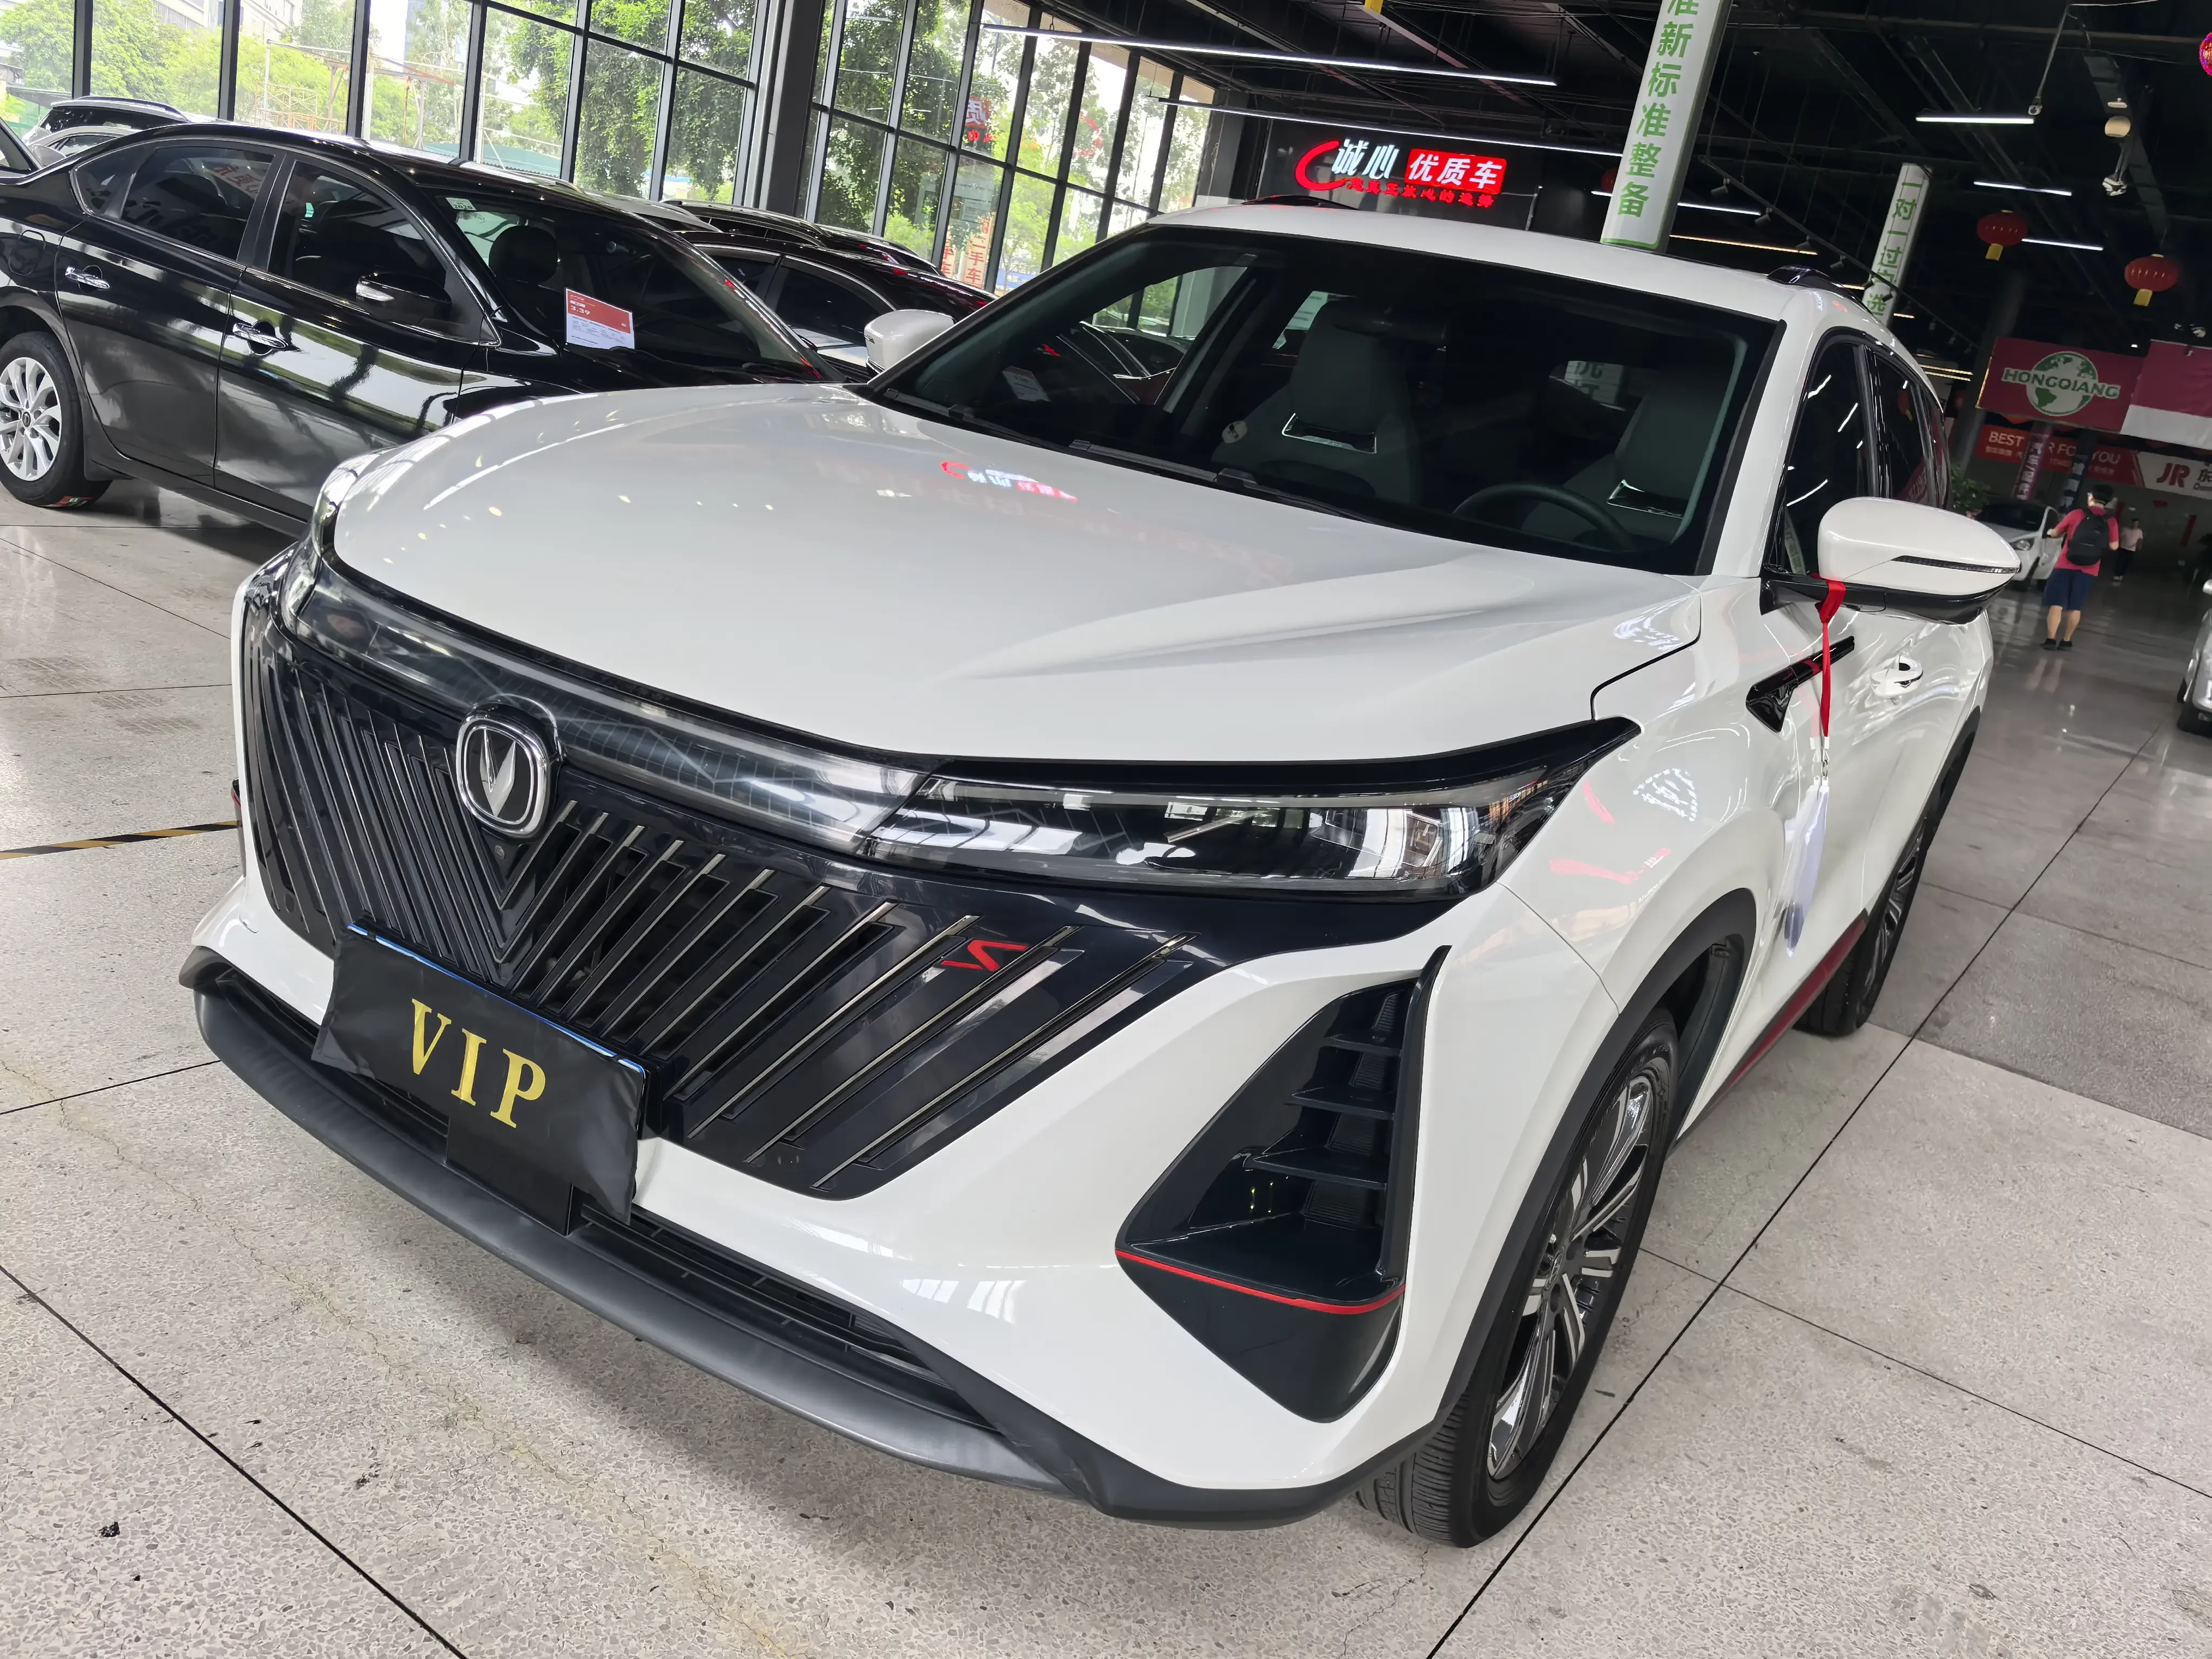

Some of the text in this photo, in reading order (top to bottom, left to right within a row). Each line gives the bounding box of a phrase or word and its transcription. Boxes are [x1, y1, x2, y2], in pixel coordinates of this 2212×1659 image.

[1331, 138, 1503, 189] 诚心 优质车
[2003, 368, 2119, 398] HONGQIANG
[1988, 431, 2025, 447] BEST
[2156, 463, 2190, 488] JR
[412, 998, 547, 1129] VIP
